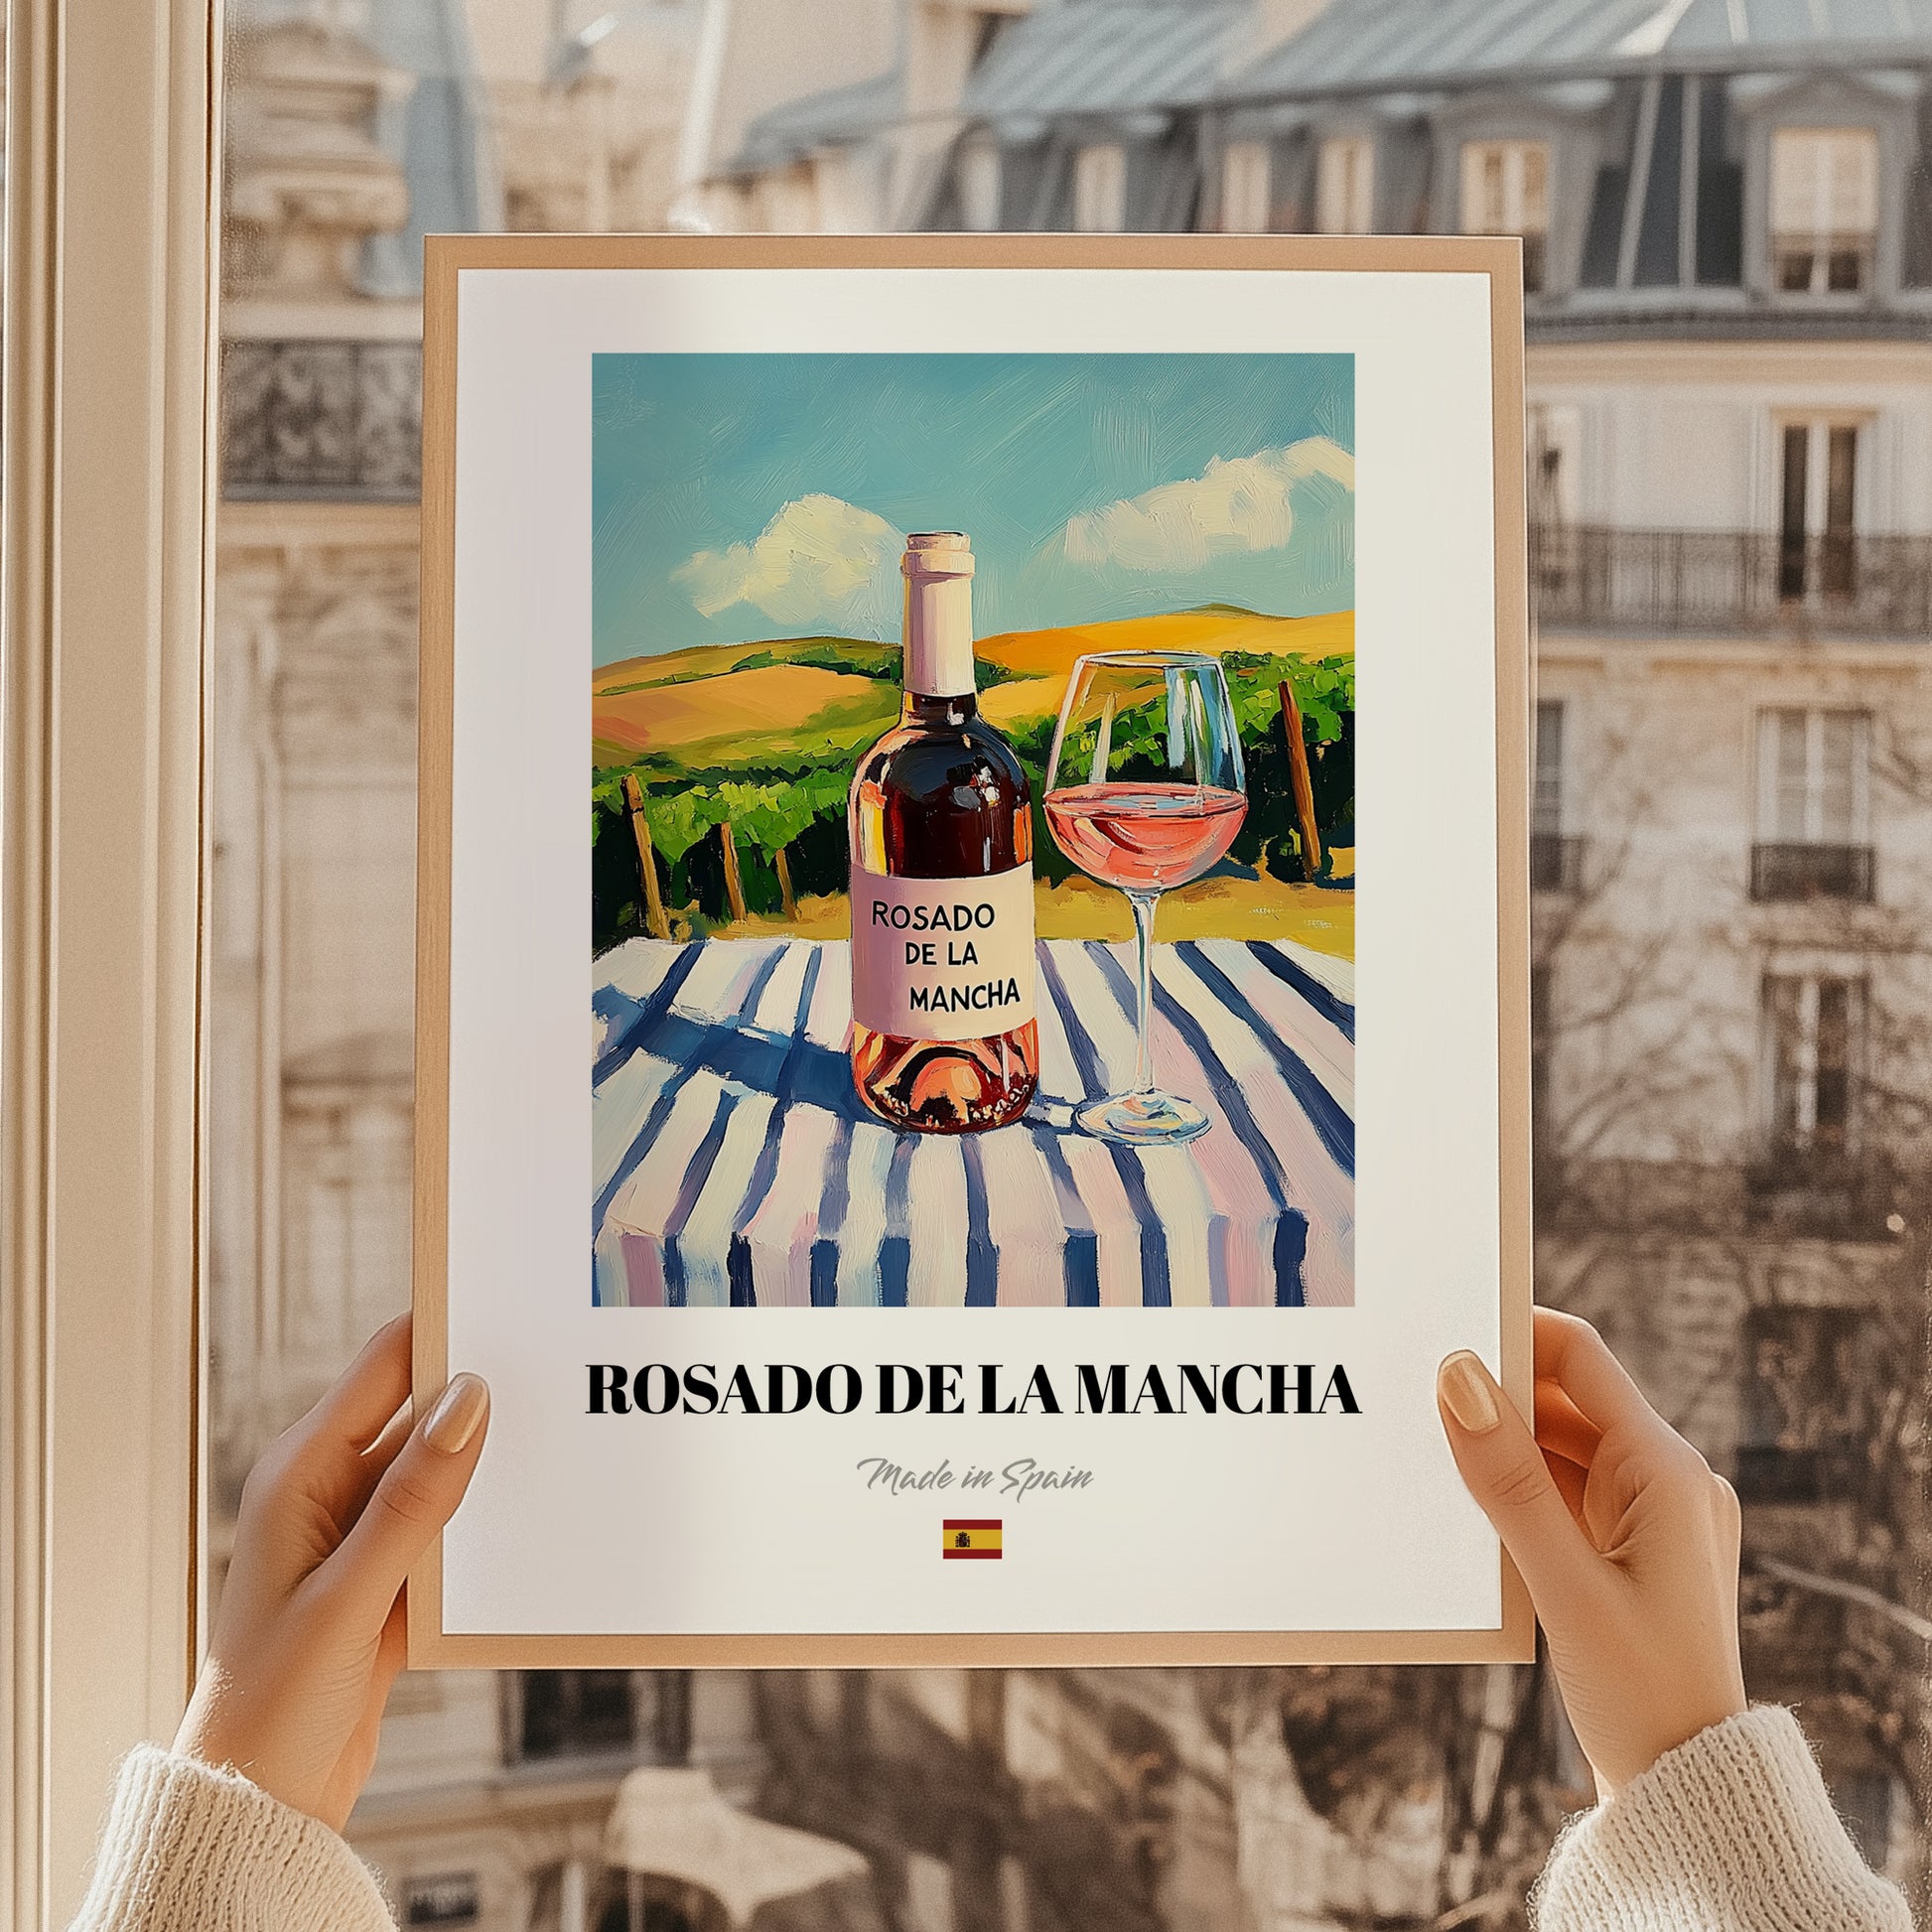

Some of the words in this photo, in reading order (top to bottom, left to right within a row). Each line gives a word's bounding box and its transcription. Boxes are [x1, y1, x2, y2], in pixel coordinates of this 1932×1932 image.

[872, 899, 995, 932] ROSADO
[904, 941, 937, 966] DE
[948, 941, 979, 966] LA
[909, 977, 1021, 1013] MANCHA
[585, 1363, 863, 1415] ROSADO
[875, 1364, 965, 1415] DE
[977, 1364, 1064, 1415] LA
[1074, 1363, 1363, 1415] MANCHA
[856, 1456, 957, 1496] Made
[960, 1463, 995, 1490] in
[999, 1456, 1095, 1505] Spain
